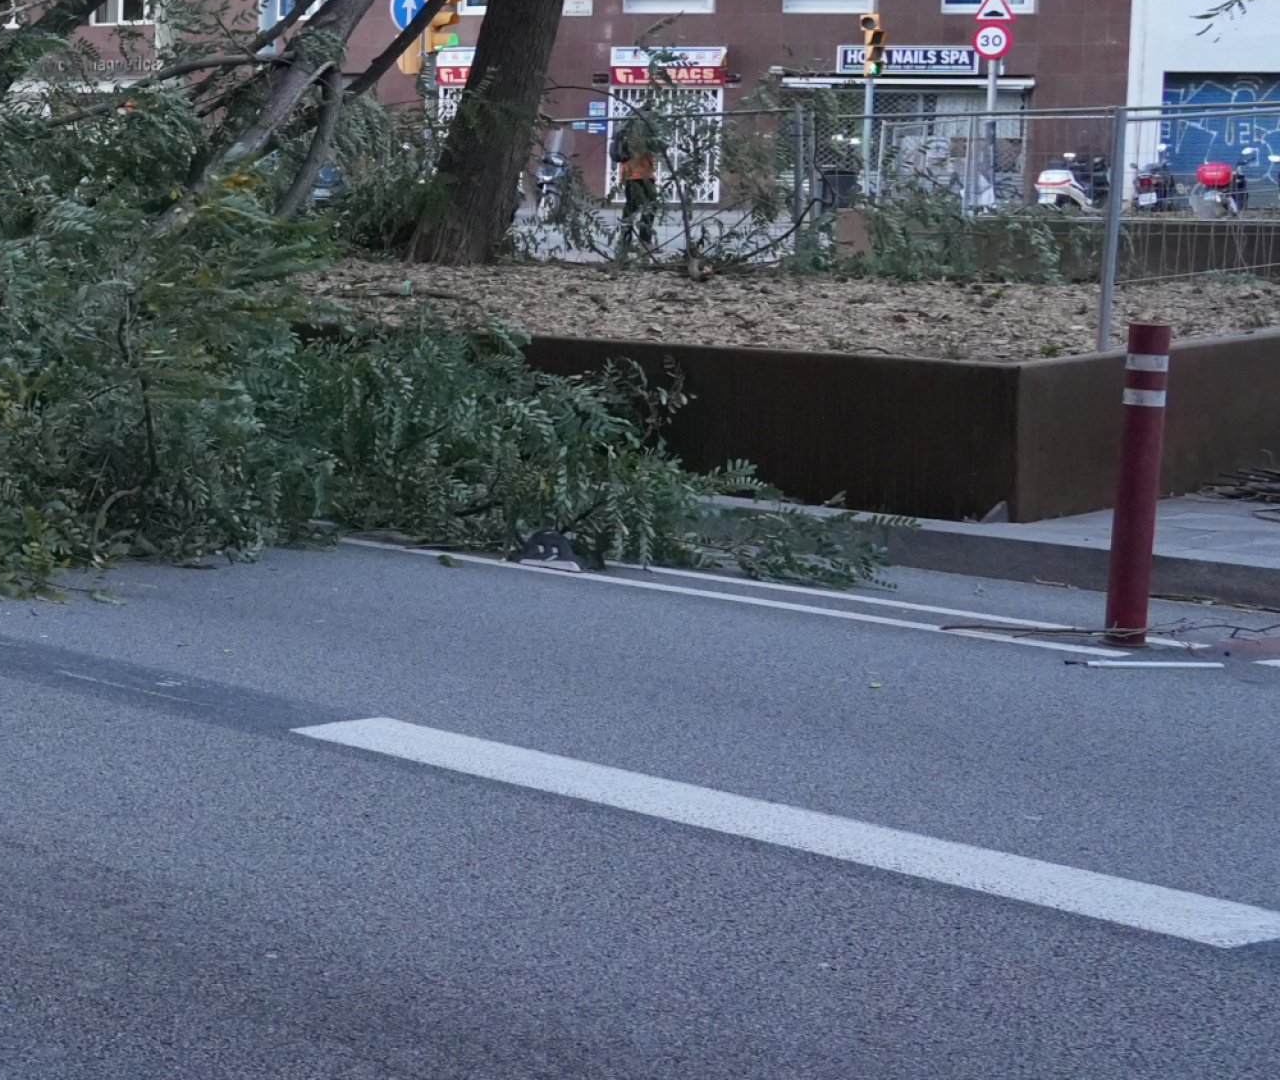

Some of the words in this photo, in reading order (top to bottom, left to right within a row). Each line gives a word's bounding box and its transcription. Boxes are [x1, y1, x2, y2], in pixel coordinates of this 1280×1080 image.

[980, 35, 1002, 47] 30
[847, 50, 887, 64] HOA
[891, 50, 937, 64] NAILS
[940, 50, 970, 65] SPA
[641, 68, 715, 79] TBACS
